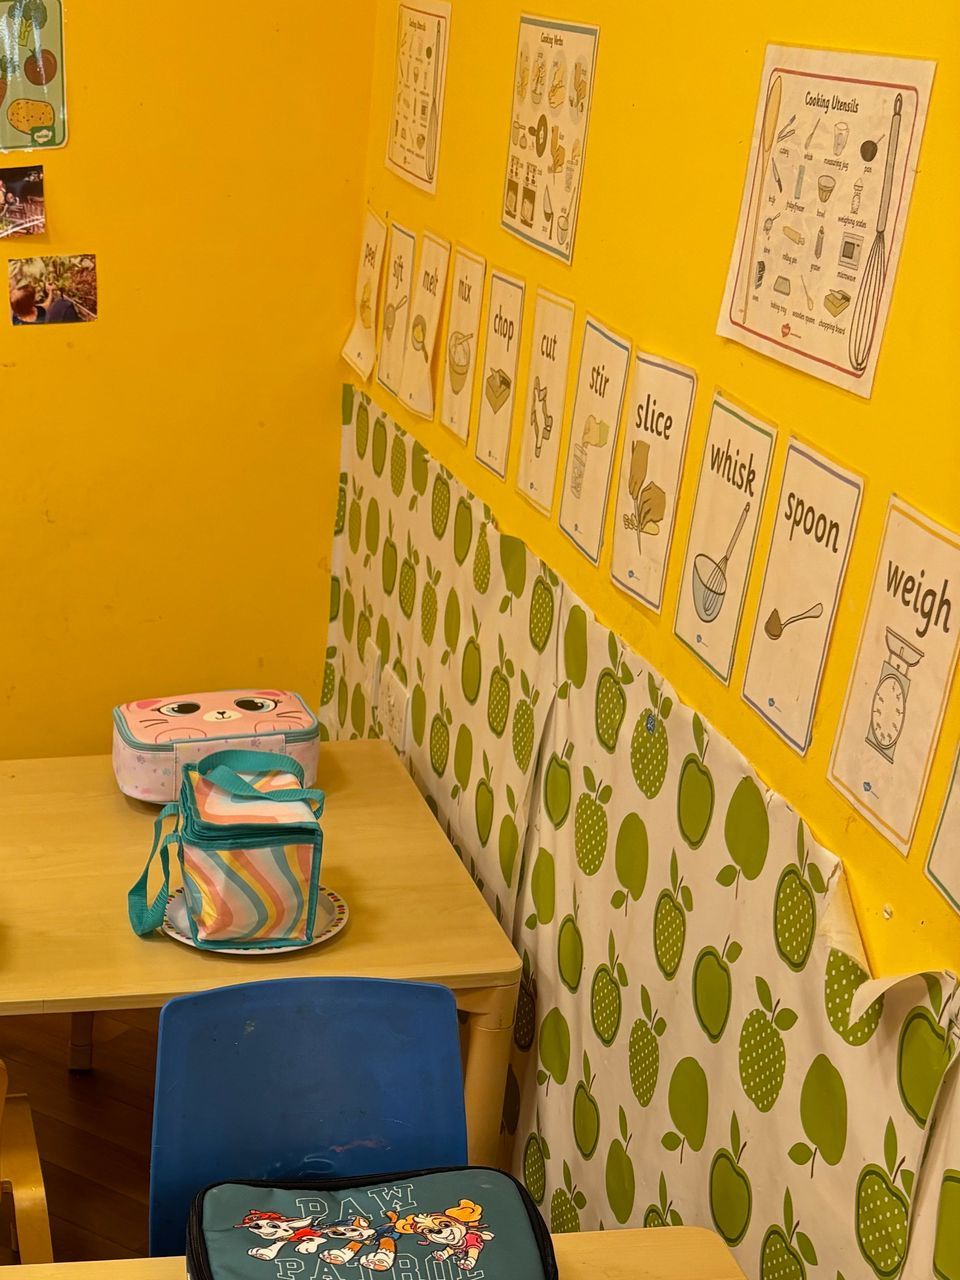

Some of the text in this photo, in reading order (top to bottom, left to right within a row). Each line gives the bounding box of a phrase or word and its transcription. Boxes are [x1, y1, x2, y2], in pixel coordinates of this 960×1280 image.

[805, 91, 859, 114] Cooking Utensils
[363, 242, 378, 271] peel
[393, 254, 404, 290] sift
[423, 267, 439, 297] melt
[458, 275, 472, 304] mix
[493, 304, 514, 352] chop
[540, 331, 557, 362] cut
[589, 364, 610, 399] stir
[635, 394, 673, 441] slice
[710, 440, 756, 498] whisk
[784, 490, 840, 554] spoon
[886, 559, 952, 639] weigh
[295, 1184, 418, 1221] PAW
